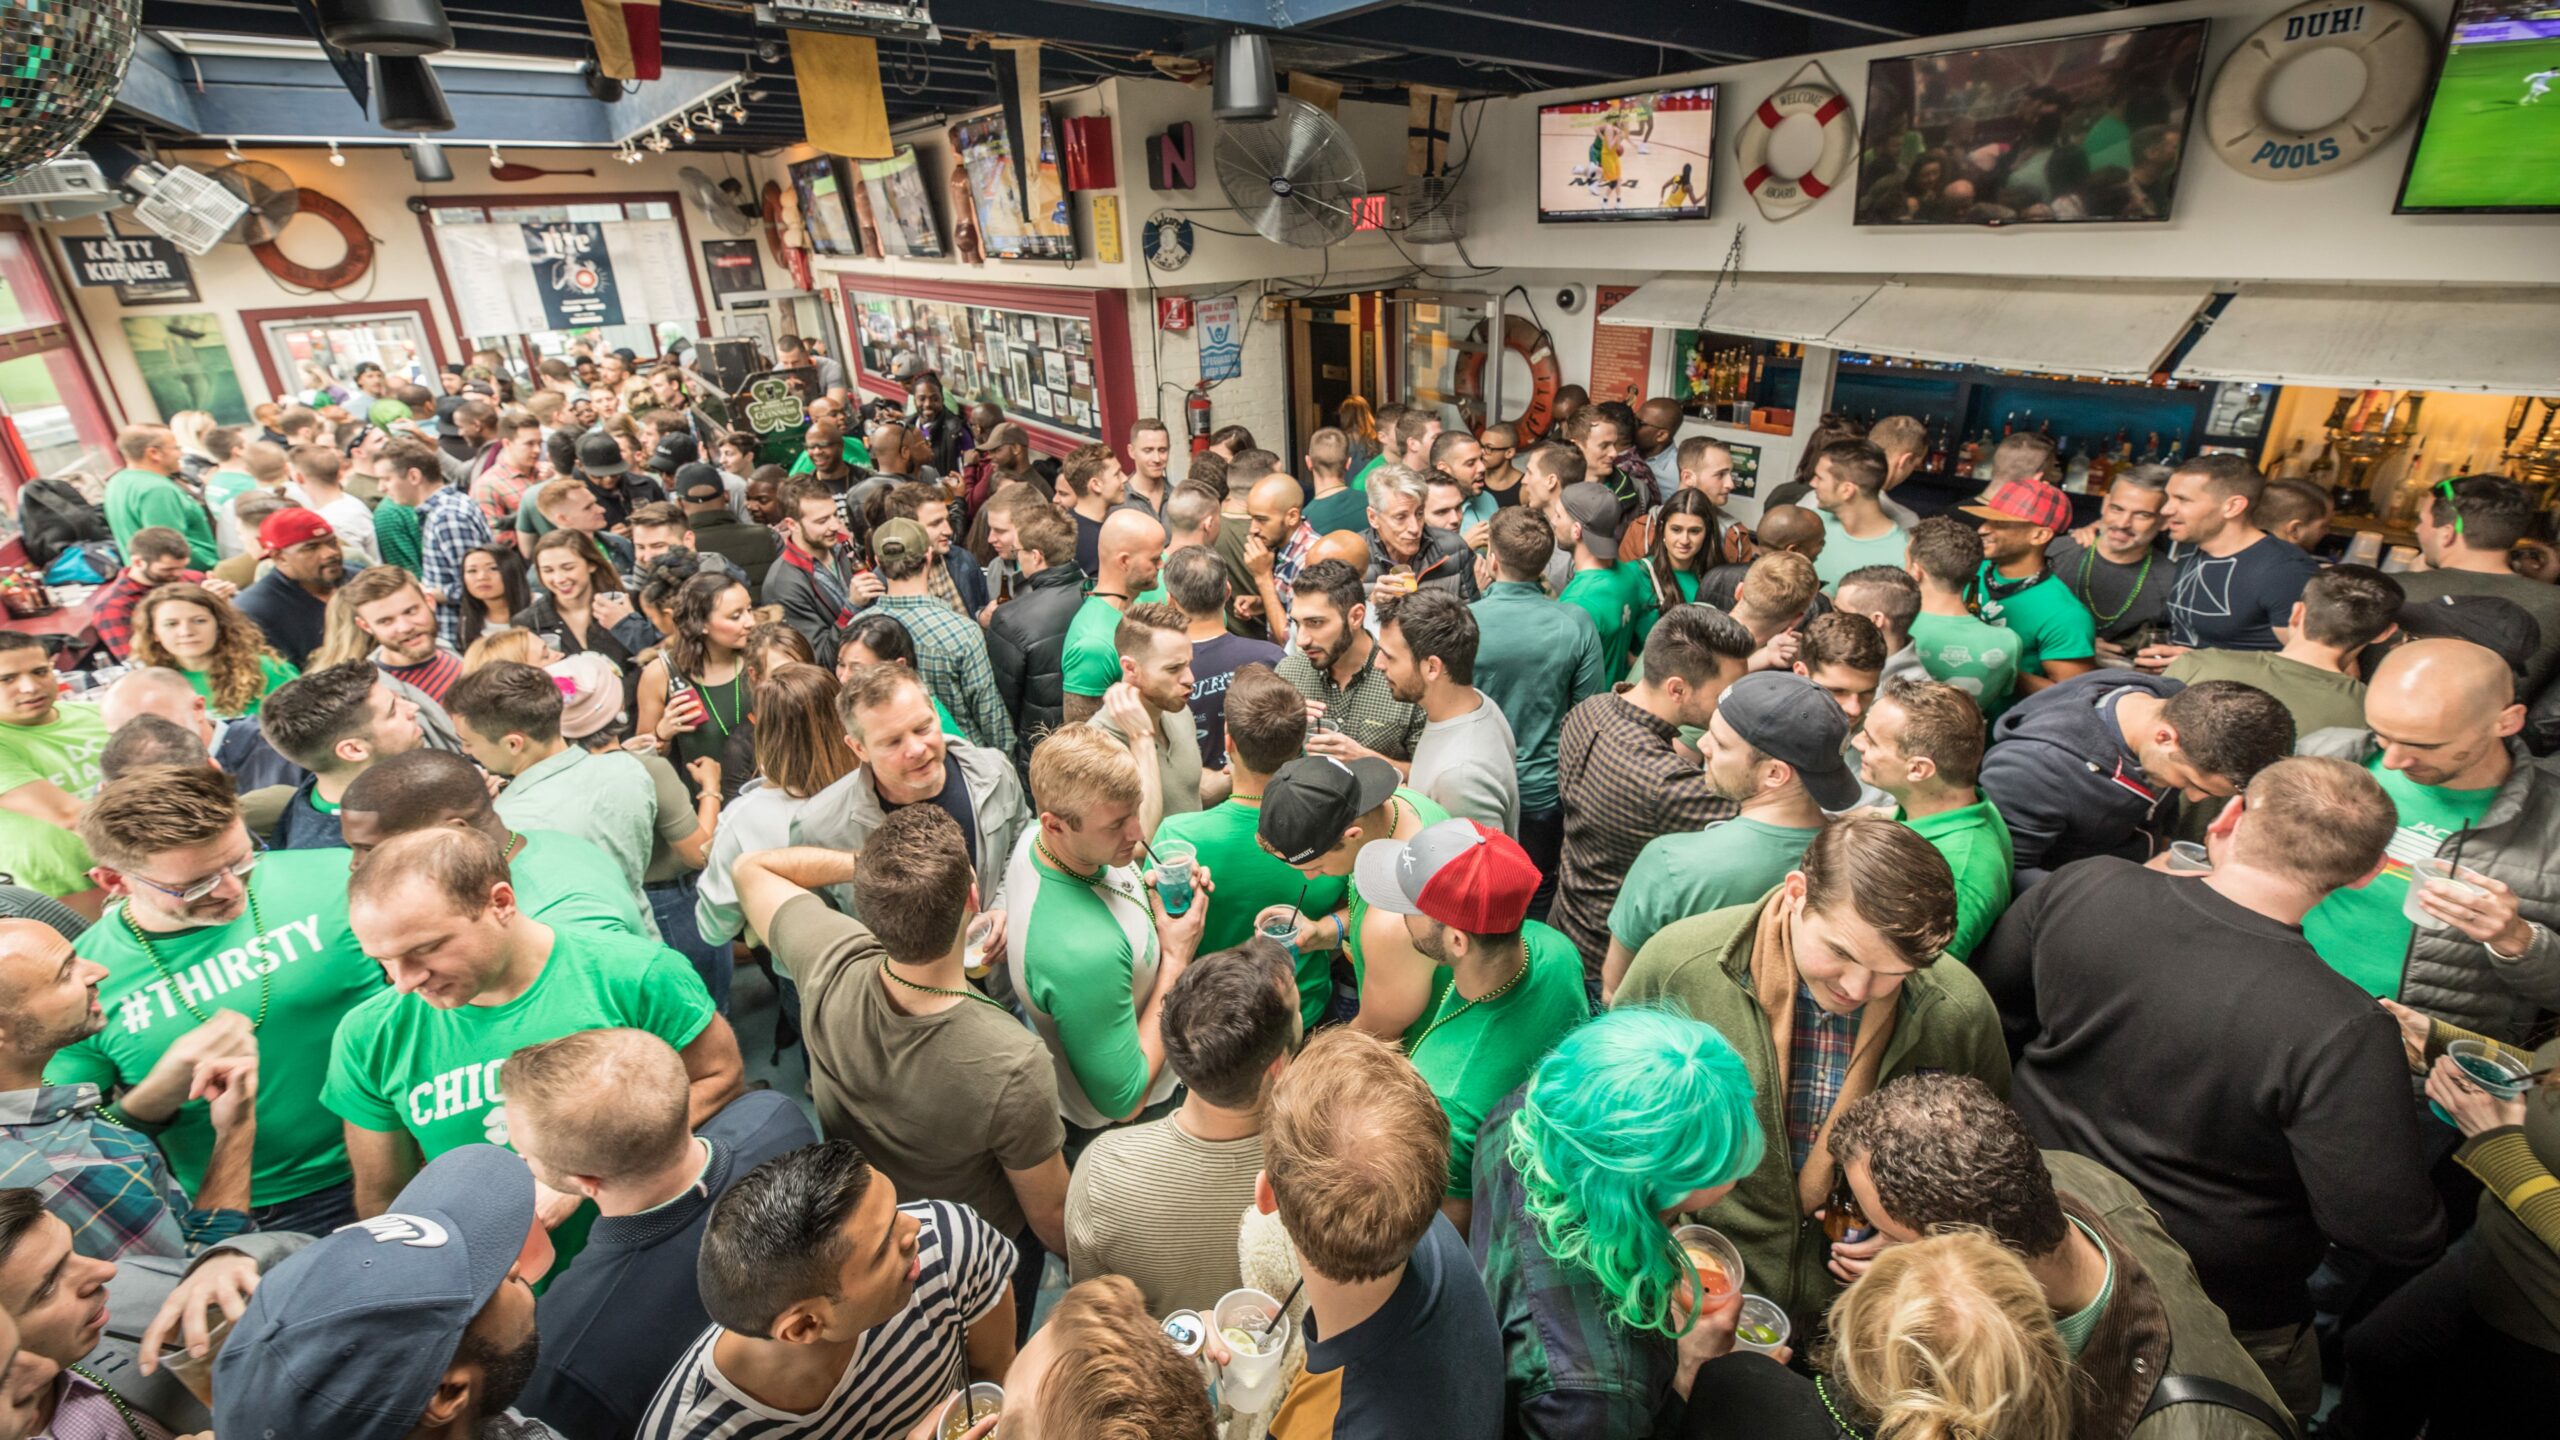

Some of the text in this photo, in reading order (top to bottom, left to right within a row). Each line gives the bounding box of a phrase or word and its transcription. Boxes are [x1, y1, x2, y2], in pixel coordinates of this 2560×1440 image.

[2284, 6, 2364, 41] DUH!
[1779, 91, 1824, 106] WELCOME
[2252, 137, 2340, 169] POOLS
[1764, 186, 1797, 199] ABOARD
[1351, 196, 1386, 230] EXIT
[82, 240, 154, 260] KATTY
[755, 405, 797, 421] GUINNESS
[119, 914, 324, 1035] #THIRSTY
